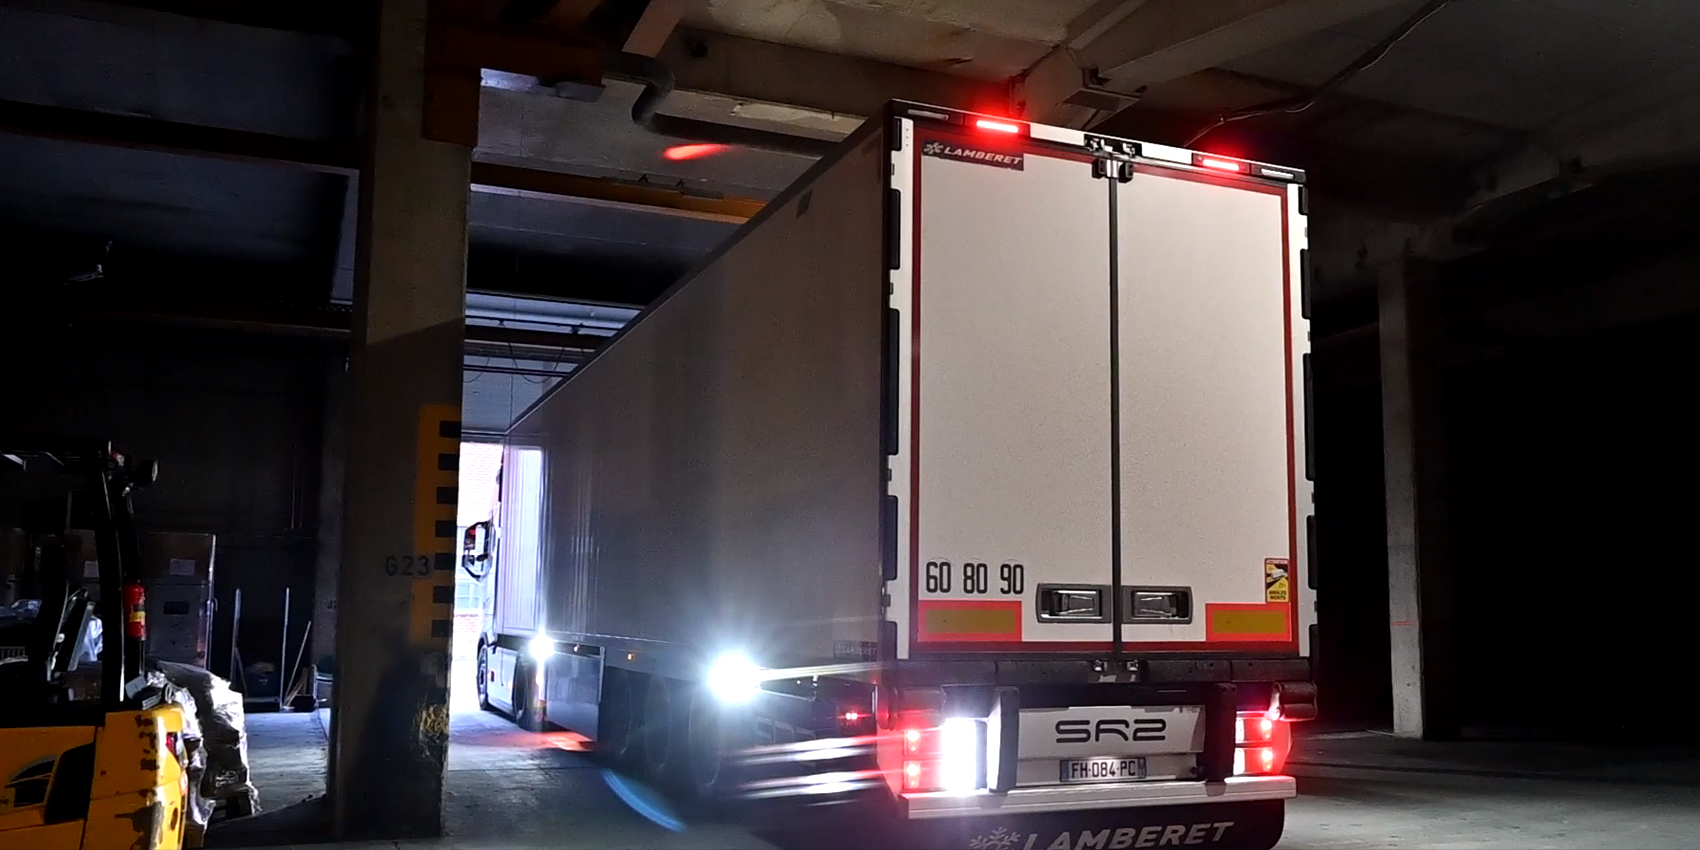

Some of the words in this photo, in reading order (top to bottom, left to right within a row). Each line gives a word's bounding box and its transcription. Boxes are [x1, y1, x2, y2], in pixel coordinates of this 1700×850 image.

[944, 146, 1022, 165] LAMBERET
[386, 555, 429, 576] G23
[926, 561, 952, 594] 60
[963, 562, 988, 594] 80
[1000, 563, 1025, 595] 90
[1055, 718, 1166, 743] SR2
[1023, 821, 1235, 850] LAMBERET
